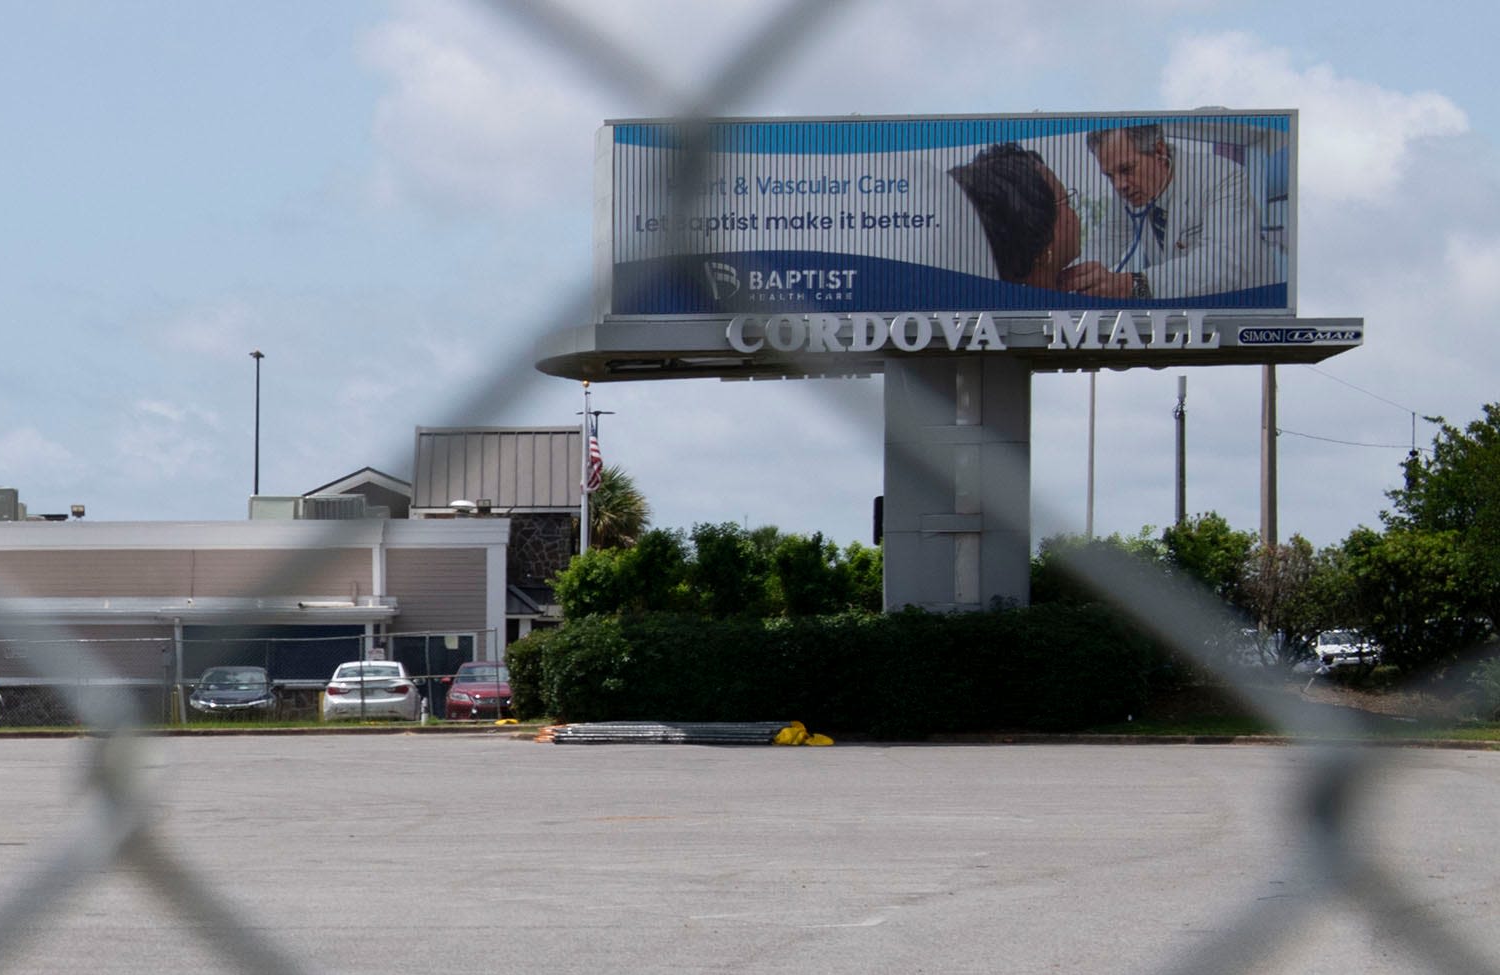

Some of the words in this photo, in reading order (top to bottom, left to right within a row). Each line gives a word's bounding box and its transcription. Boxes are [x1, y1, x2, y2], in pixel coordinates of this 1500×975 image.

[733, 176, 749, 196] &
[756, 175, 851, 196] Vascular
[857, 174, 909, 195] Care
[765, 211, 833, 231] make
[840, 211, 855, 231] it
[861, 210, 940, 231] better.
[749, 269, 858, 291] BAPTIST
[815, 292, 853, 301] CARE
[726, 311, 1007, 353] CORDOVA
[1043, 311, 1221, 351] MALL
[1242, 330, 1281, 342] SIMON
[1288, 330, 1356, 341] LAMAR
